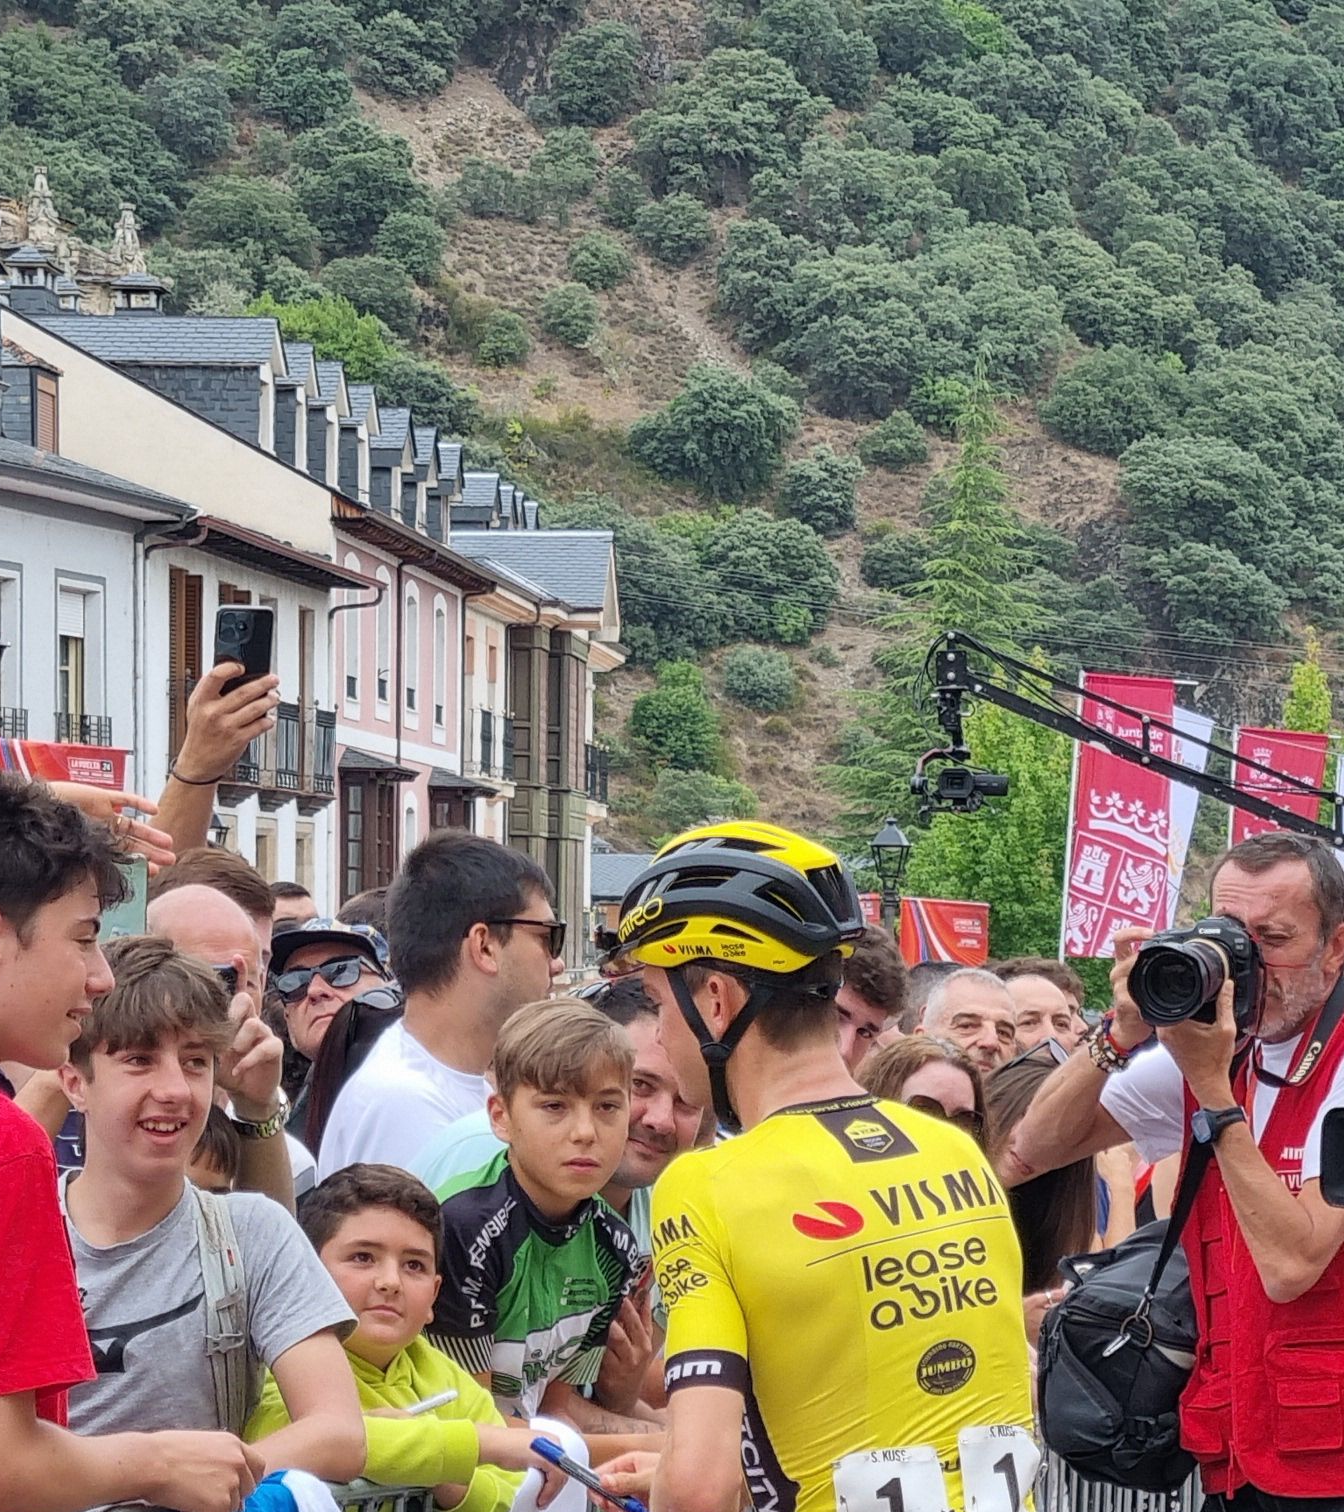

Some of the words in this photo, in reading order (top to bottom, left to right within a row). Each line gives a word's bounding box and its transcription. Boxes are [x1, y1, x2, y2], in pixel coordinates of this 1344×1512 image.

[1116, 726, 1145, 740] Junt
[618, 897, 663, 943] GIRO
[678, 944, 713, 955] VISMA
[1289, 1041, 1322, 1083] Canon
[869, 1167, 1005, 1226] VISMA
[650, 1214, 699, 1258] SMA
[658, 1257, 692, 1289] ase
[861, 1237, 987, 1293] lease
[919, 1357, 974, 1379] JUMBO
